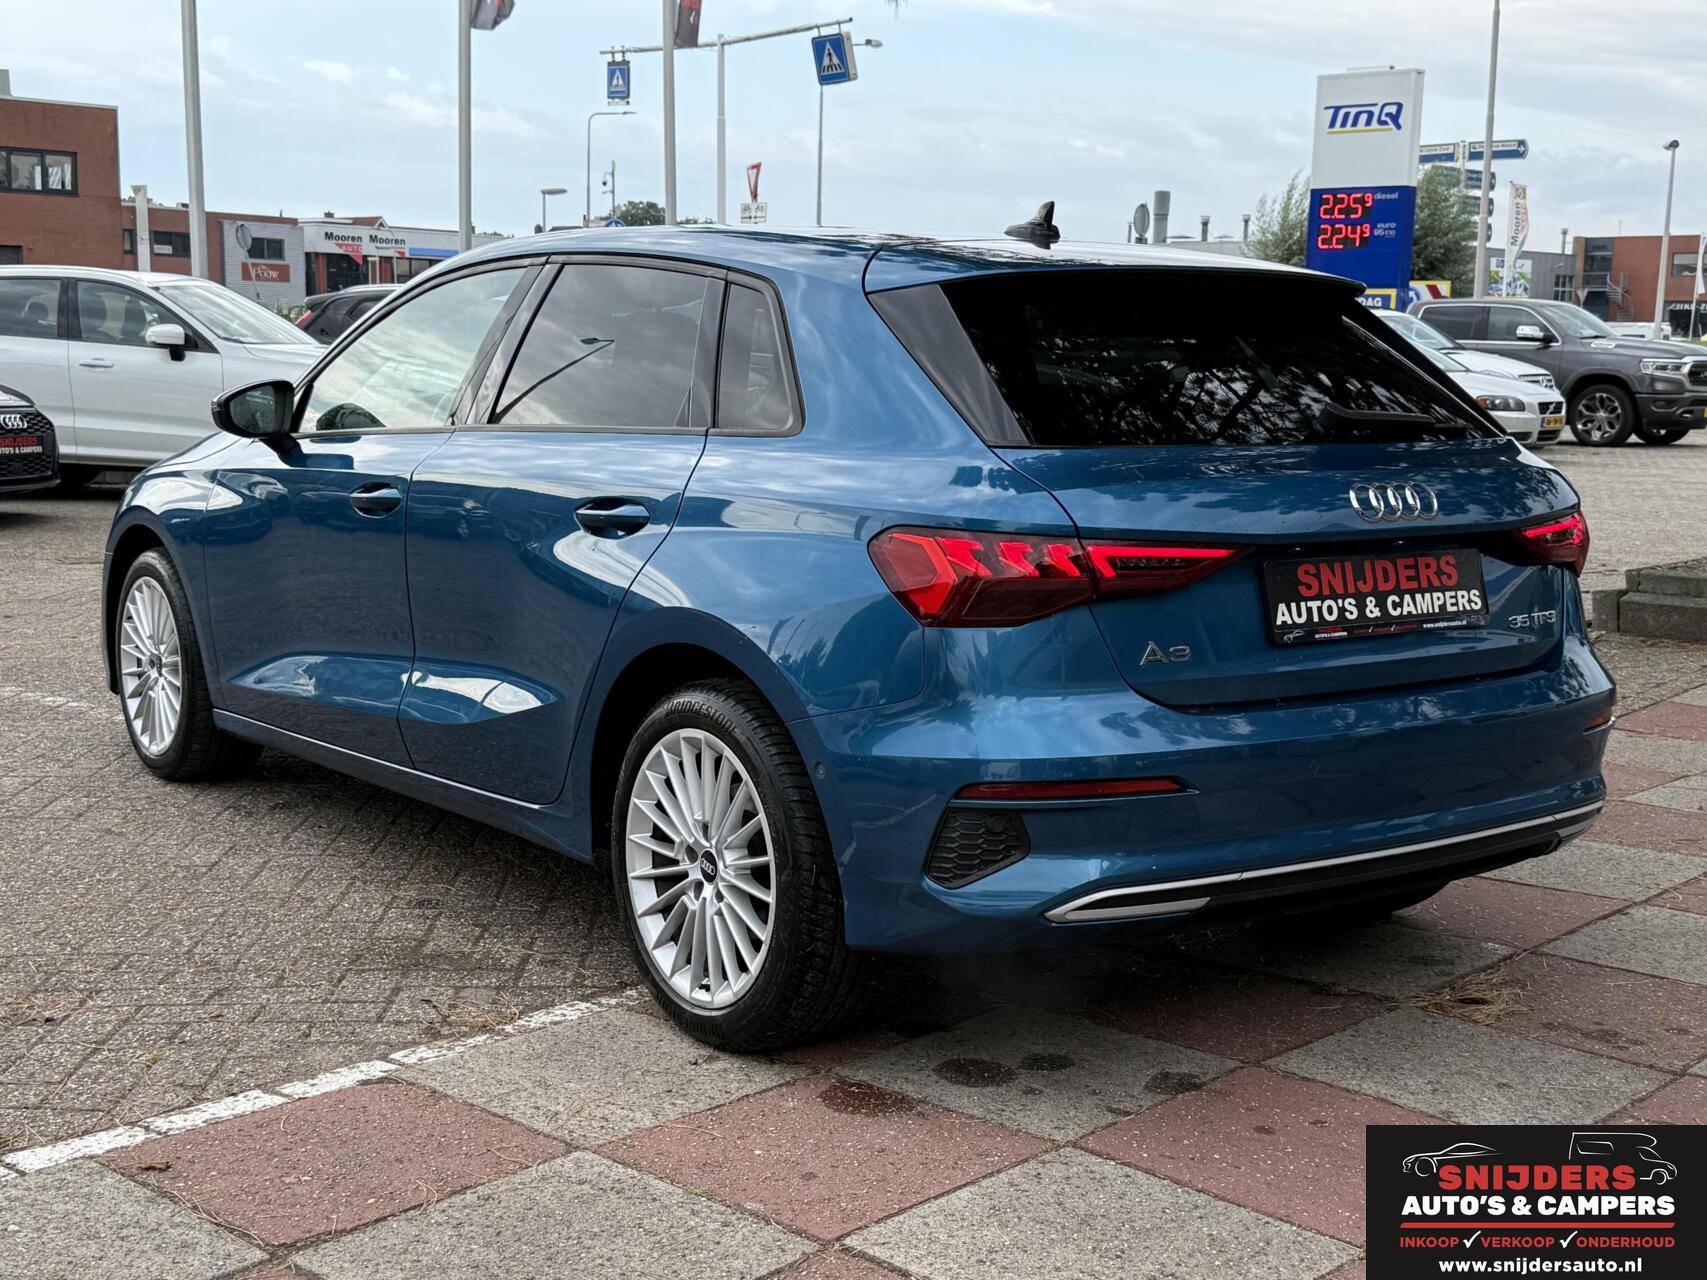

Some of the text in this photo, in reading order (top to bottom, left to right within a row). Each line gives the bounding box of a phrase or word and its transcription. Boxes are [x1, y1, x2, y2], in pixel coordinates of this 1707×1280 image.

[1374, 192, 1399, 200] diesel
[1510, 202, 1521, 247] Mooren
[324, 231, 363, 243] Mooren
[369, 234, 406, 246] Mooren
[1355, 296, 1383, 307] DAG
[1297, 554, 1459, 597] SNIJDERS
[1275, 589, 1482, 626] AUTO'S & CAMPERS
[1508, 615, 1530, 629] 35
[1139, 641, 1191, 666] A3
